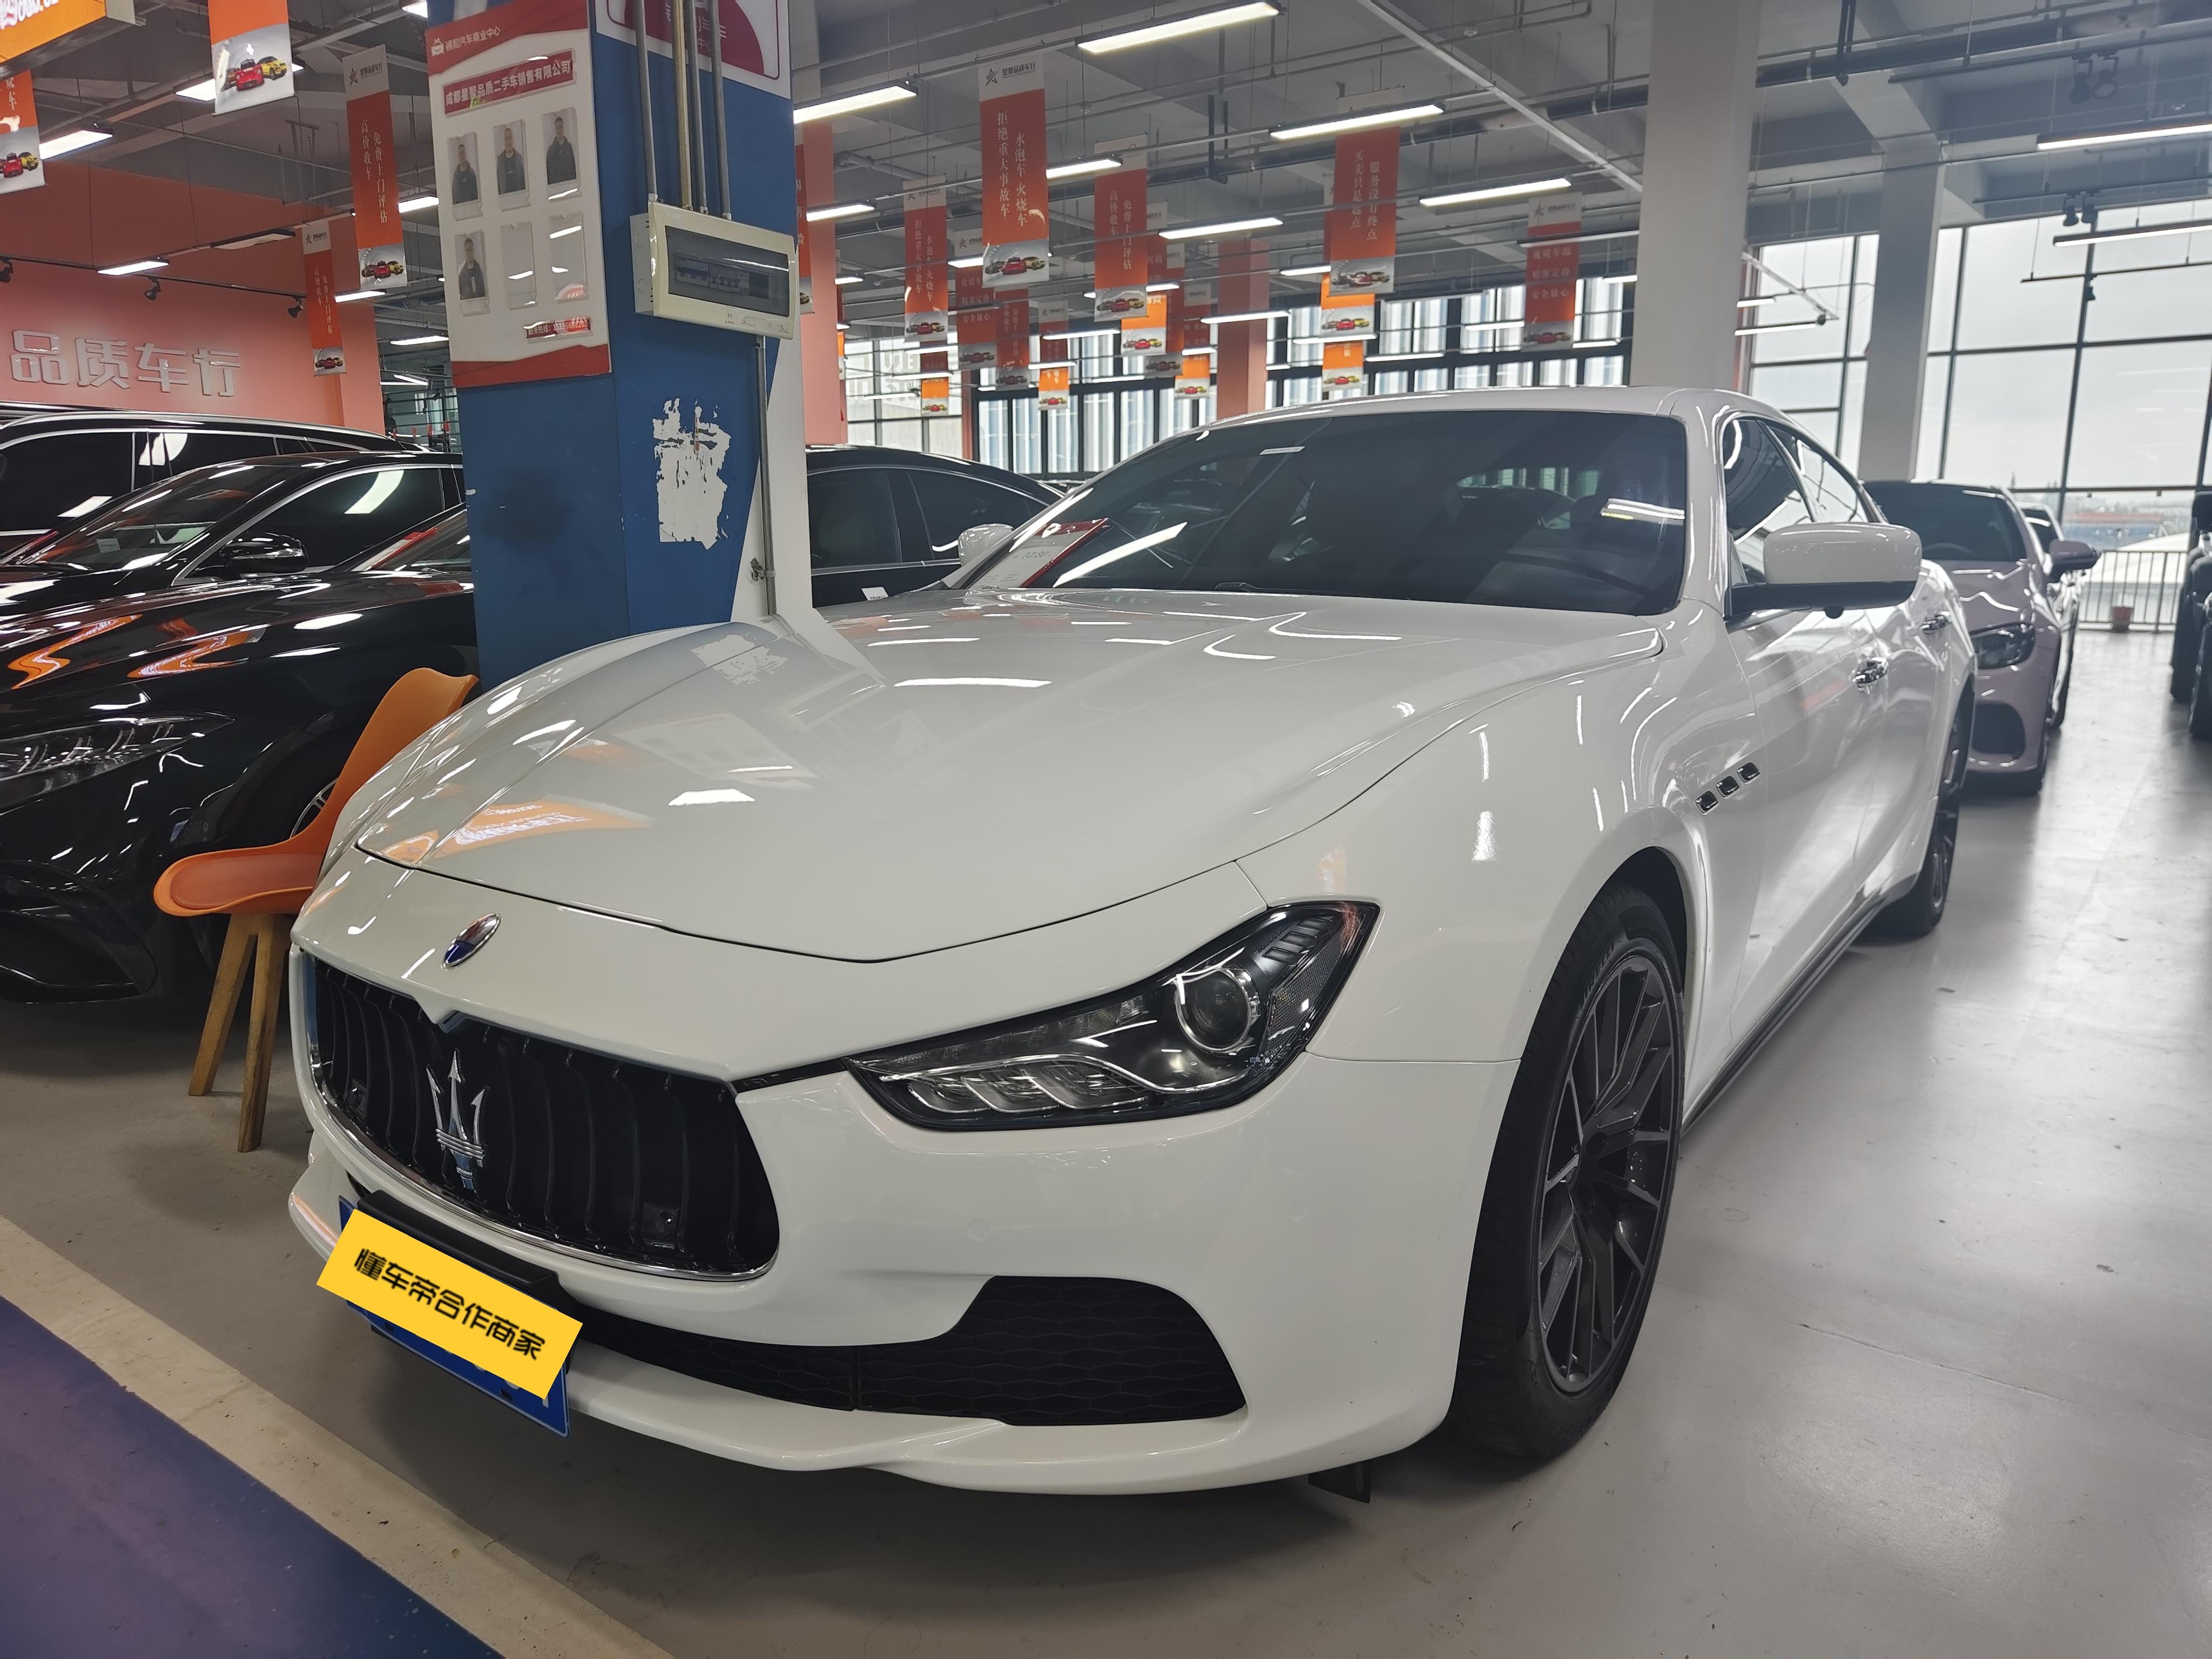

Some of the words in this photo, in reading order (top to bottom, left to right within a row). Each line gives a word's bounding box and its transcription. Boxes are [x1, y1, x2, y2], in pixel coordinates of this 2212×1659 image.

[361, 119, 373, 181] 高价收车
[374, 131, 388, 224] 免费上门评估
[997, 111, 1010, 217] 拒绝重大事故车
[10, 329, 241, 397] 品质车行
